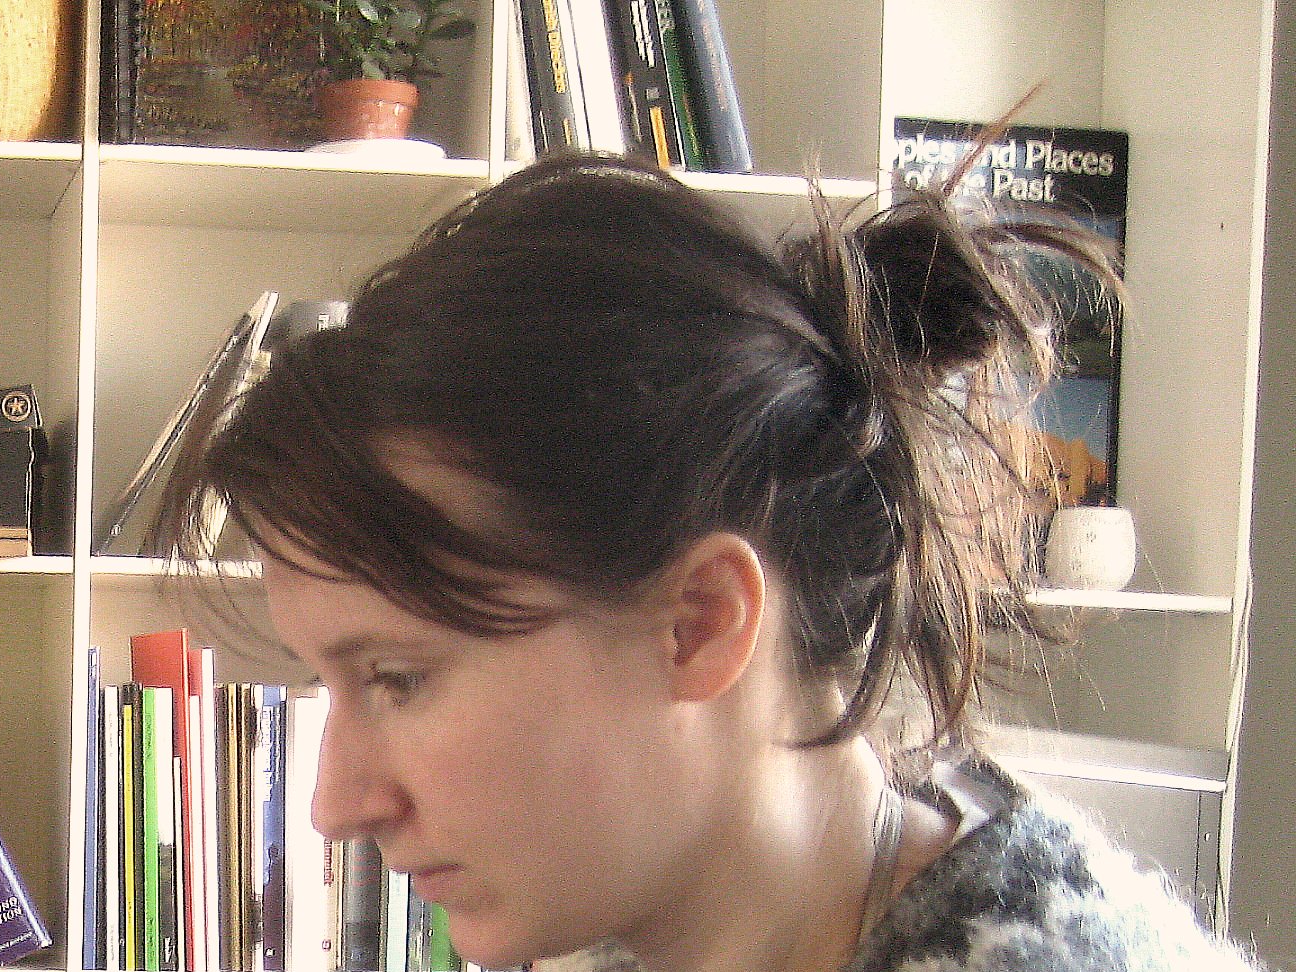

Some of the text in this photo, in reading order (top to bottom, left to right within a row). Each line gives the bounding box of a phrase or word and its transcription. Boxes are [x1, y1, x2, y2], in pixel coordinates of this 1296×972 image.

[895, 133, 954, 168] ples
[1025, 140, 1115, 176] Places
[992, 168, 1055, 201] Past
